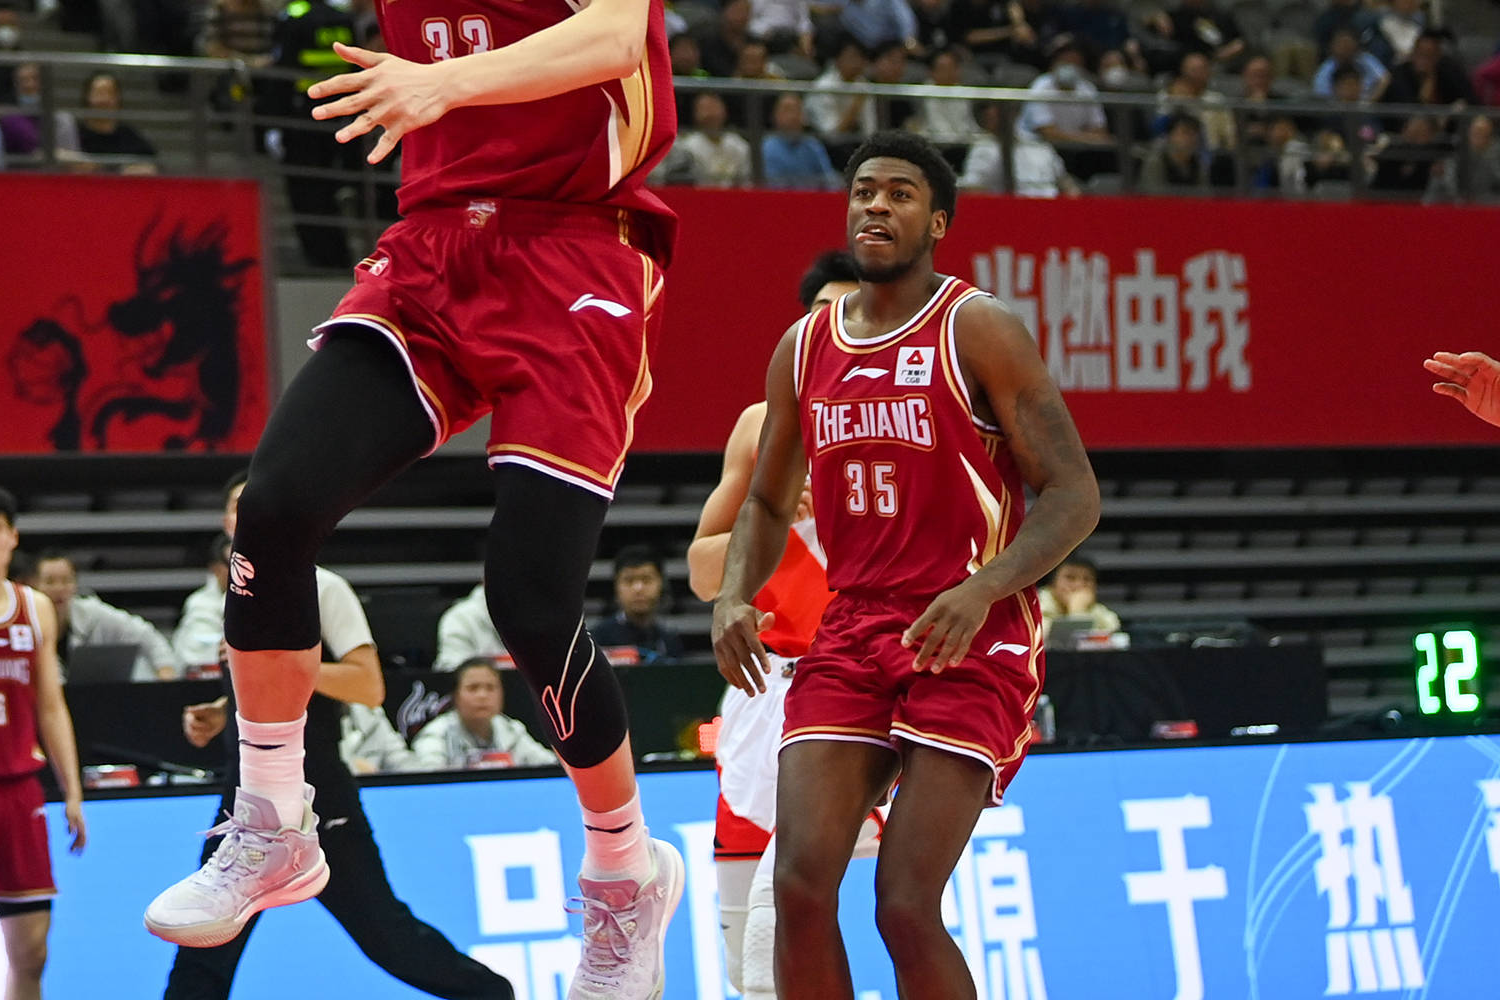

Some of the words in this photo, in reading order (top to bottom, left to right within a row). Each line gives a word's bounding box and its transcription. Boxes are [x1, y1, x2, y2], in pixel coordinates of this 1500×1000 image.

[811, 397, 933, 450] ZHEJIANG
[846, 462, 897, 515] 35
[1414, 630, 1479, 714] 22
